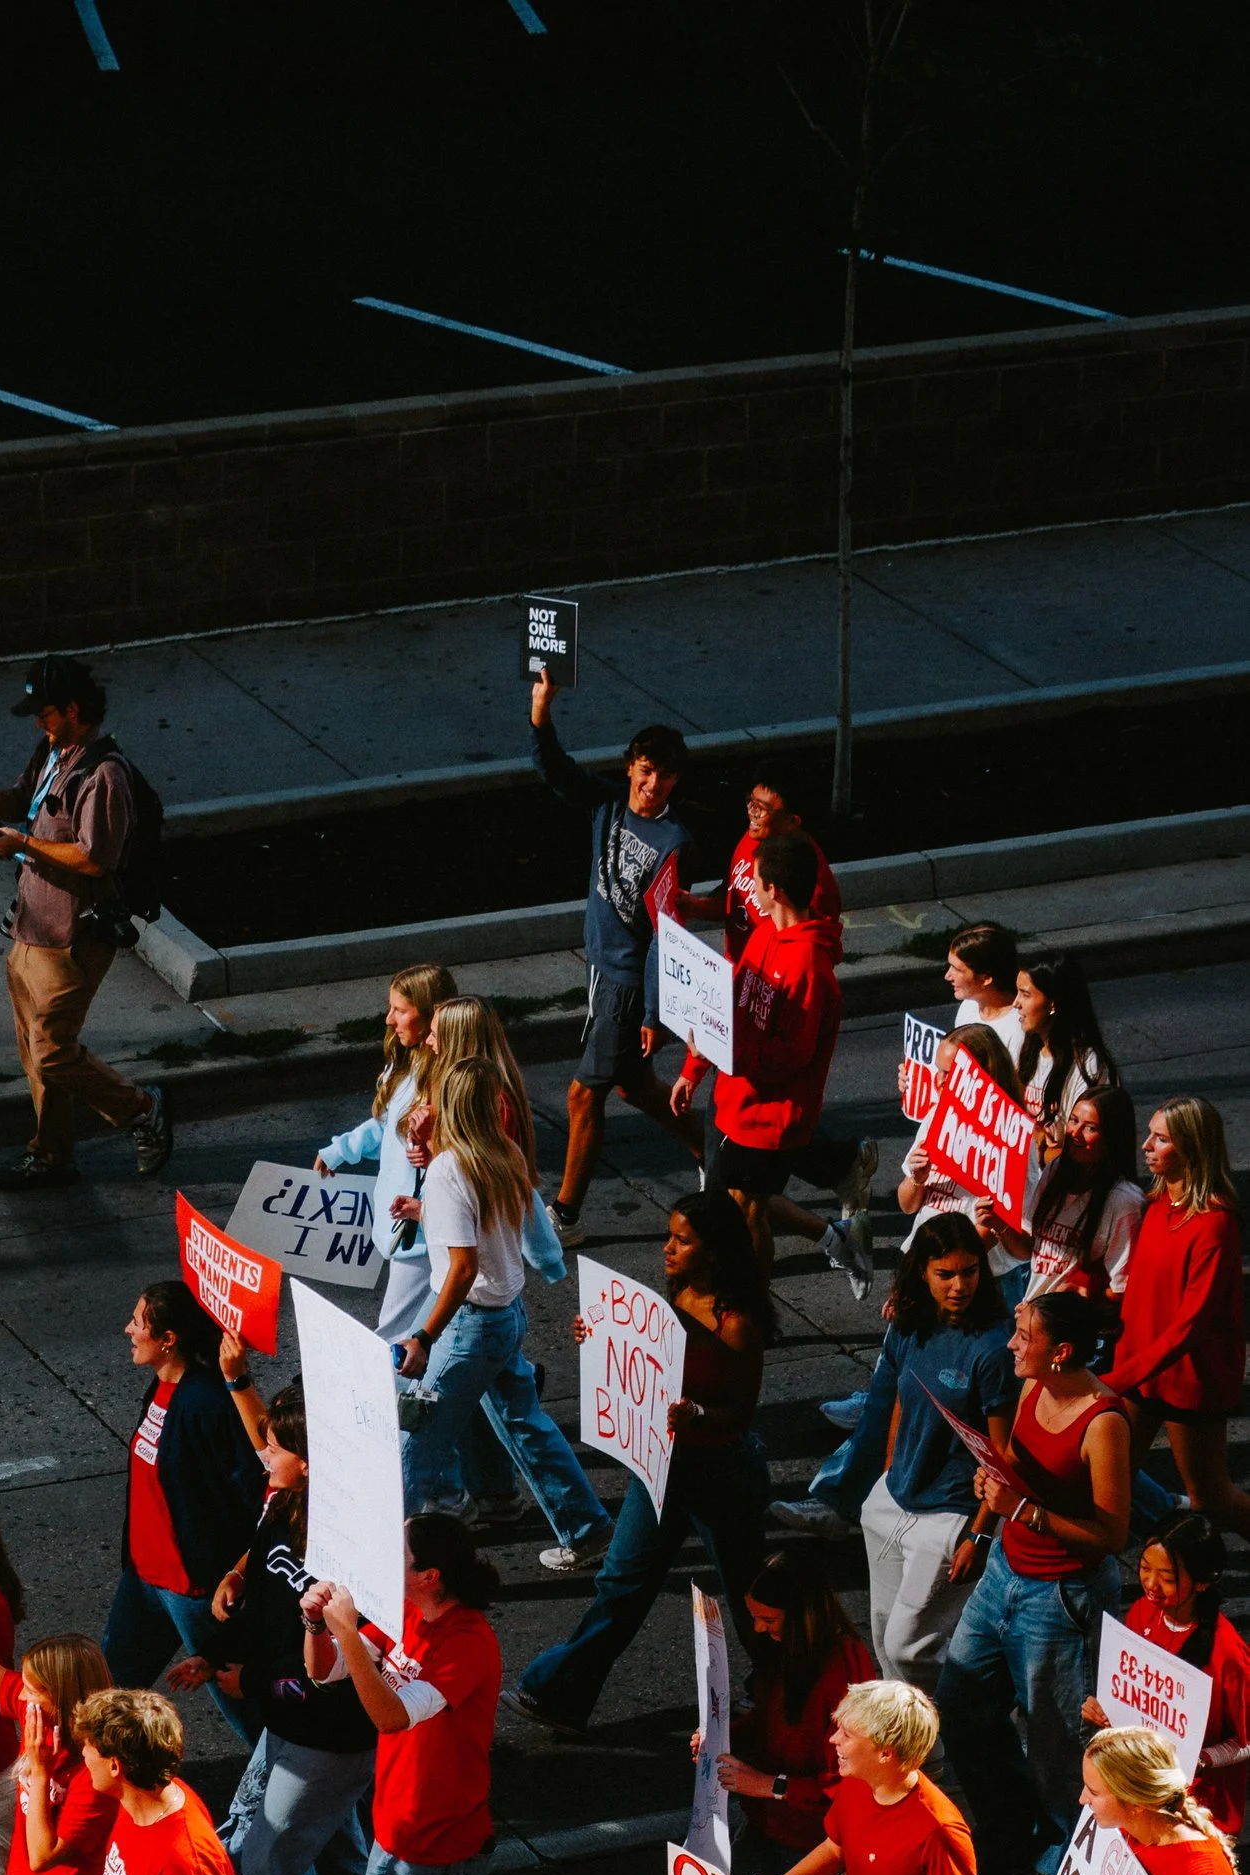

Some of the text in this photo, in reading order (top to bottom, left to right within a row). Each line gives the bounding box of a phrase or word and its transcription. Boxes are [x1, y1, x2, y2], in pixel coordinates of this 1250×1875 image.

[528, 621, 556, 638] ONE
[529, 607, 557, 624] NOT
[529, 635, 567, 654] MORE
[664, 953, 692, 987] LIVES
[993, 1104, 1036, 1156] NOT
[262, 1179, 375, 1228] NEXT?
[186, 1241, 229, 1297] DEMAND
[192, 1223, 259, 1287] STUDENTS
[284, 1224, 375, 1267] AM I
[200, 1288, 240, 1330] ACTION
[611, 1280, 675, 1367] BOOKS
[606, 1336, 664, 1421] NOT
[596, 1387, 670, 1509] BULLETS
[1119, 1650, 1174, 1701] 644-33
[1176, 1681, 1185, 1700] to
[1111, 1674, 1188, 1739] STUDENTS
[1074, 1814, 1097, 1864] A
